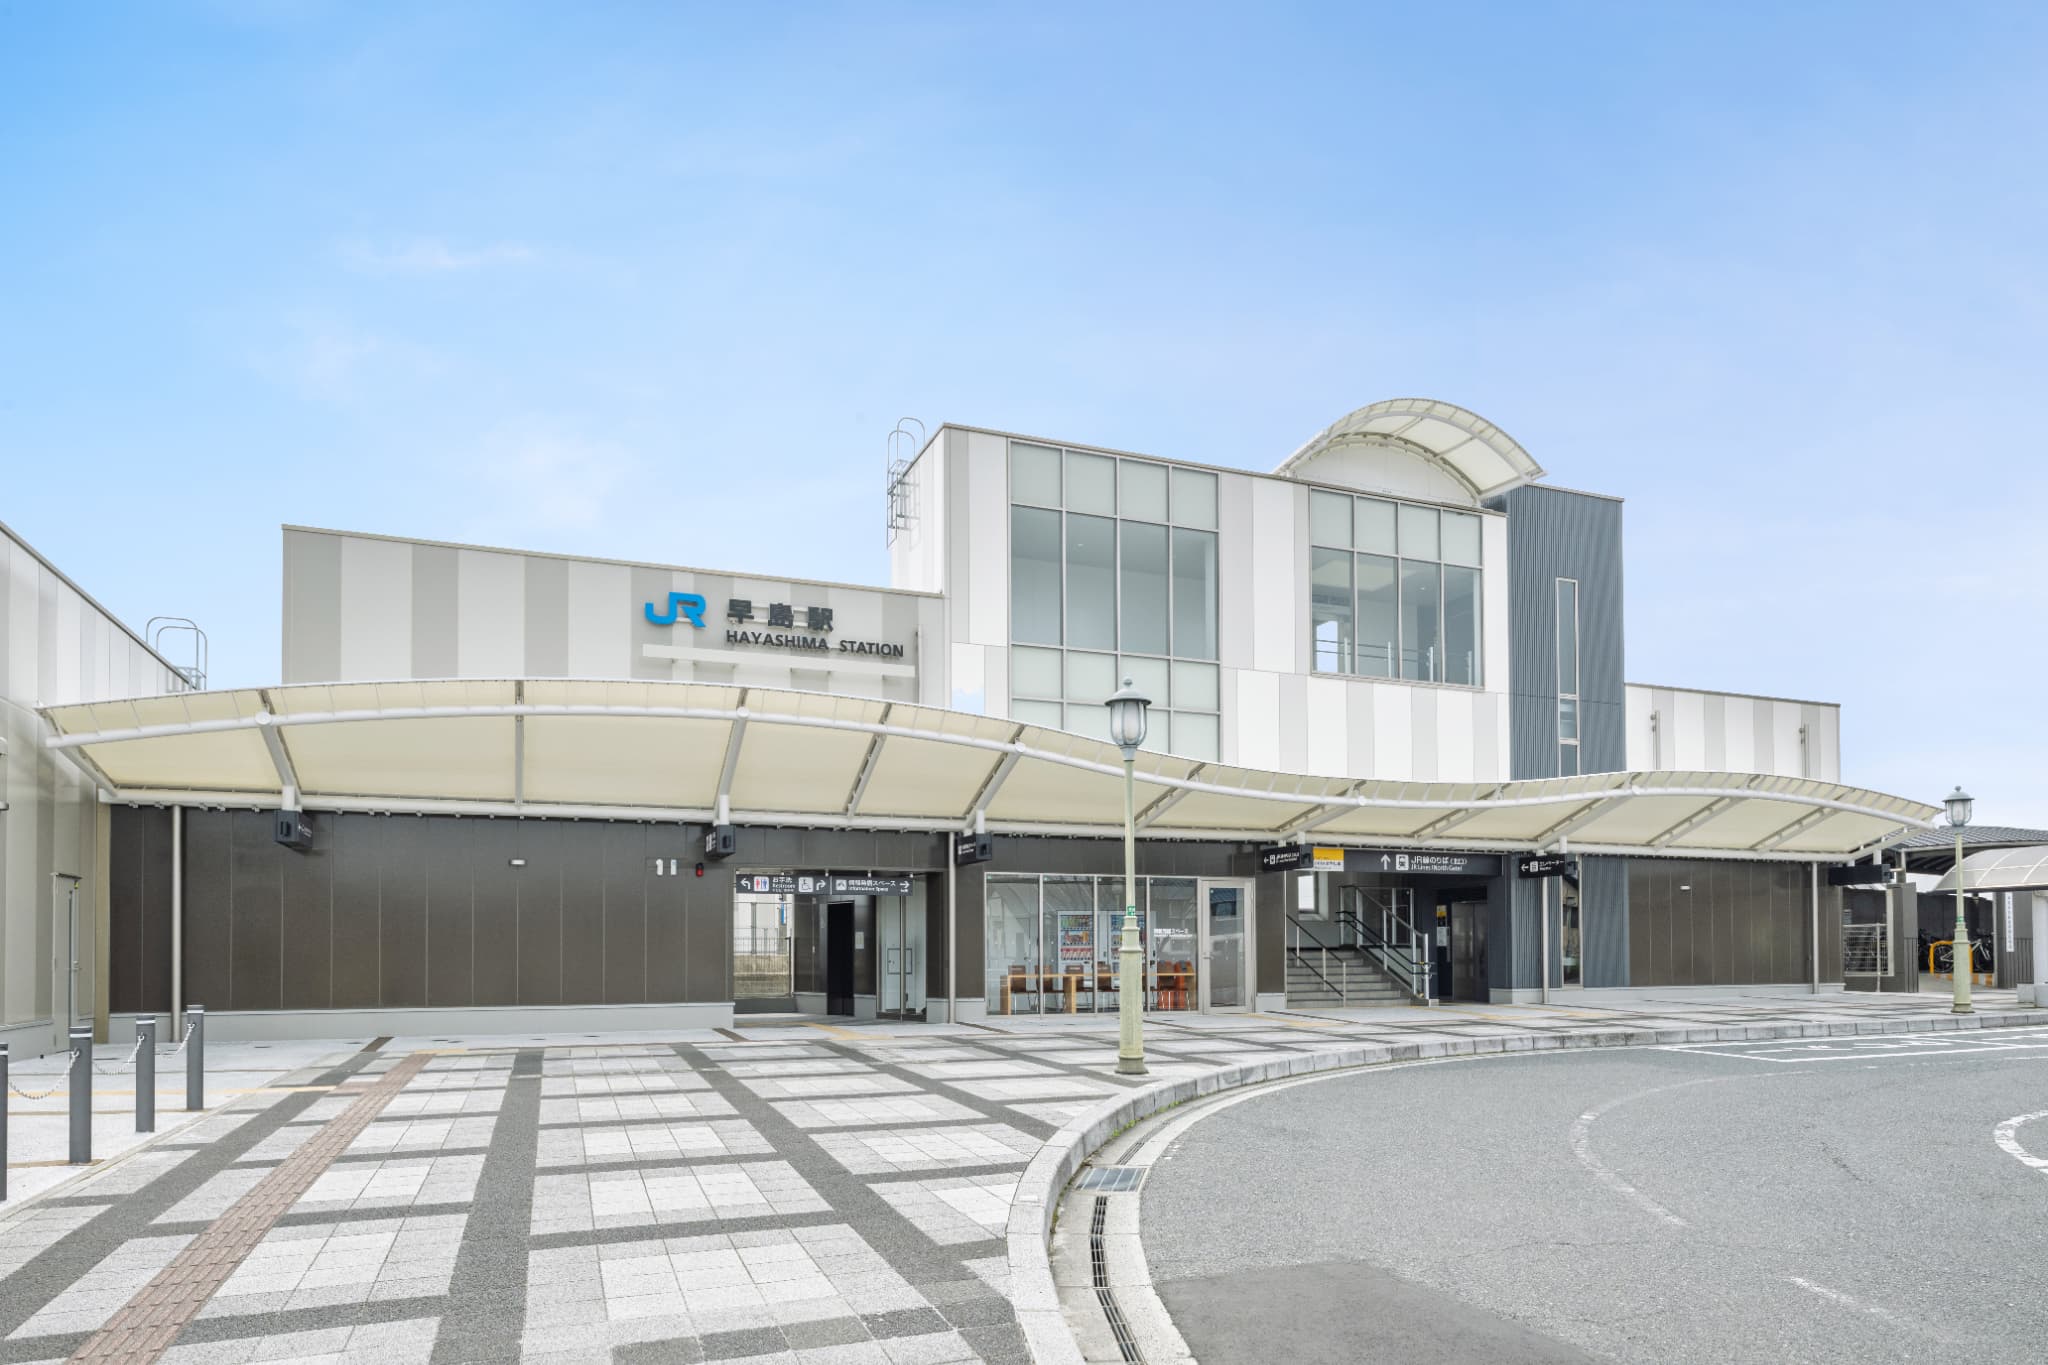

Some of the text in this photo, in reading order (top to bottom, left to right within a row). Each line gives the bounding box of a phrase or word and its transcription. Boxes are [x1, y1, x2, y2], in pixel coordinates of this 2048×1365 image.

[645, 592, 706, 628] JR
[727, 599, 834, 632] 早島駅
[726, 629, 904, 658] HAYASHIMA STATION
